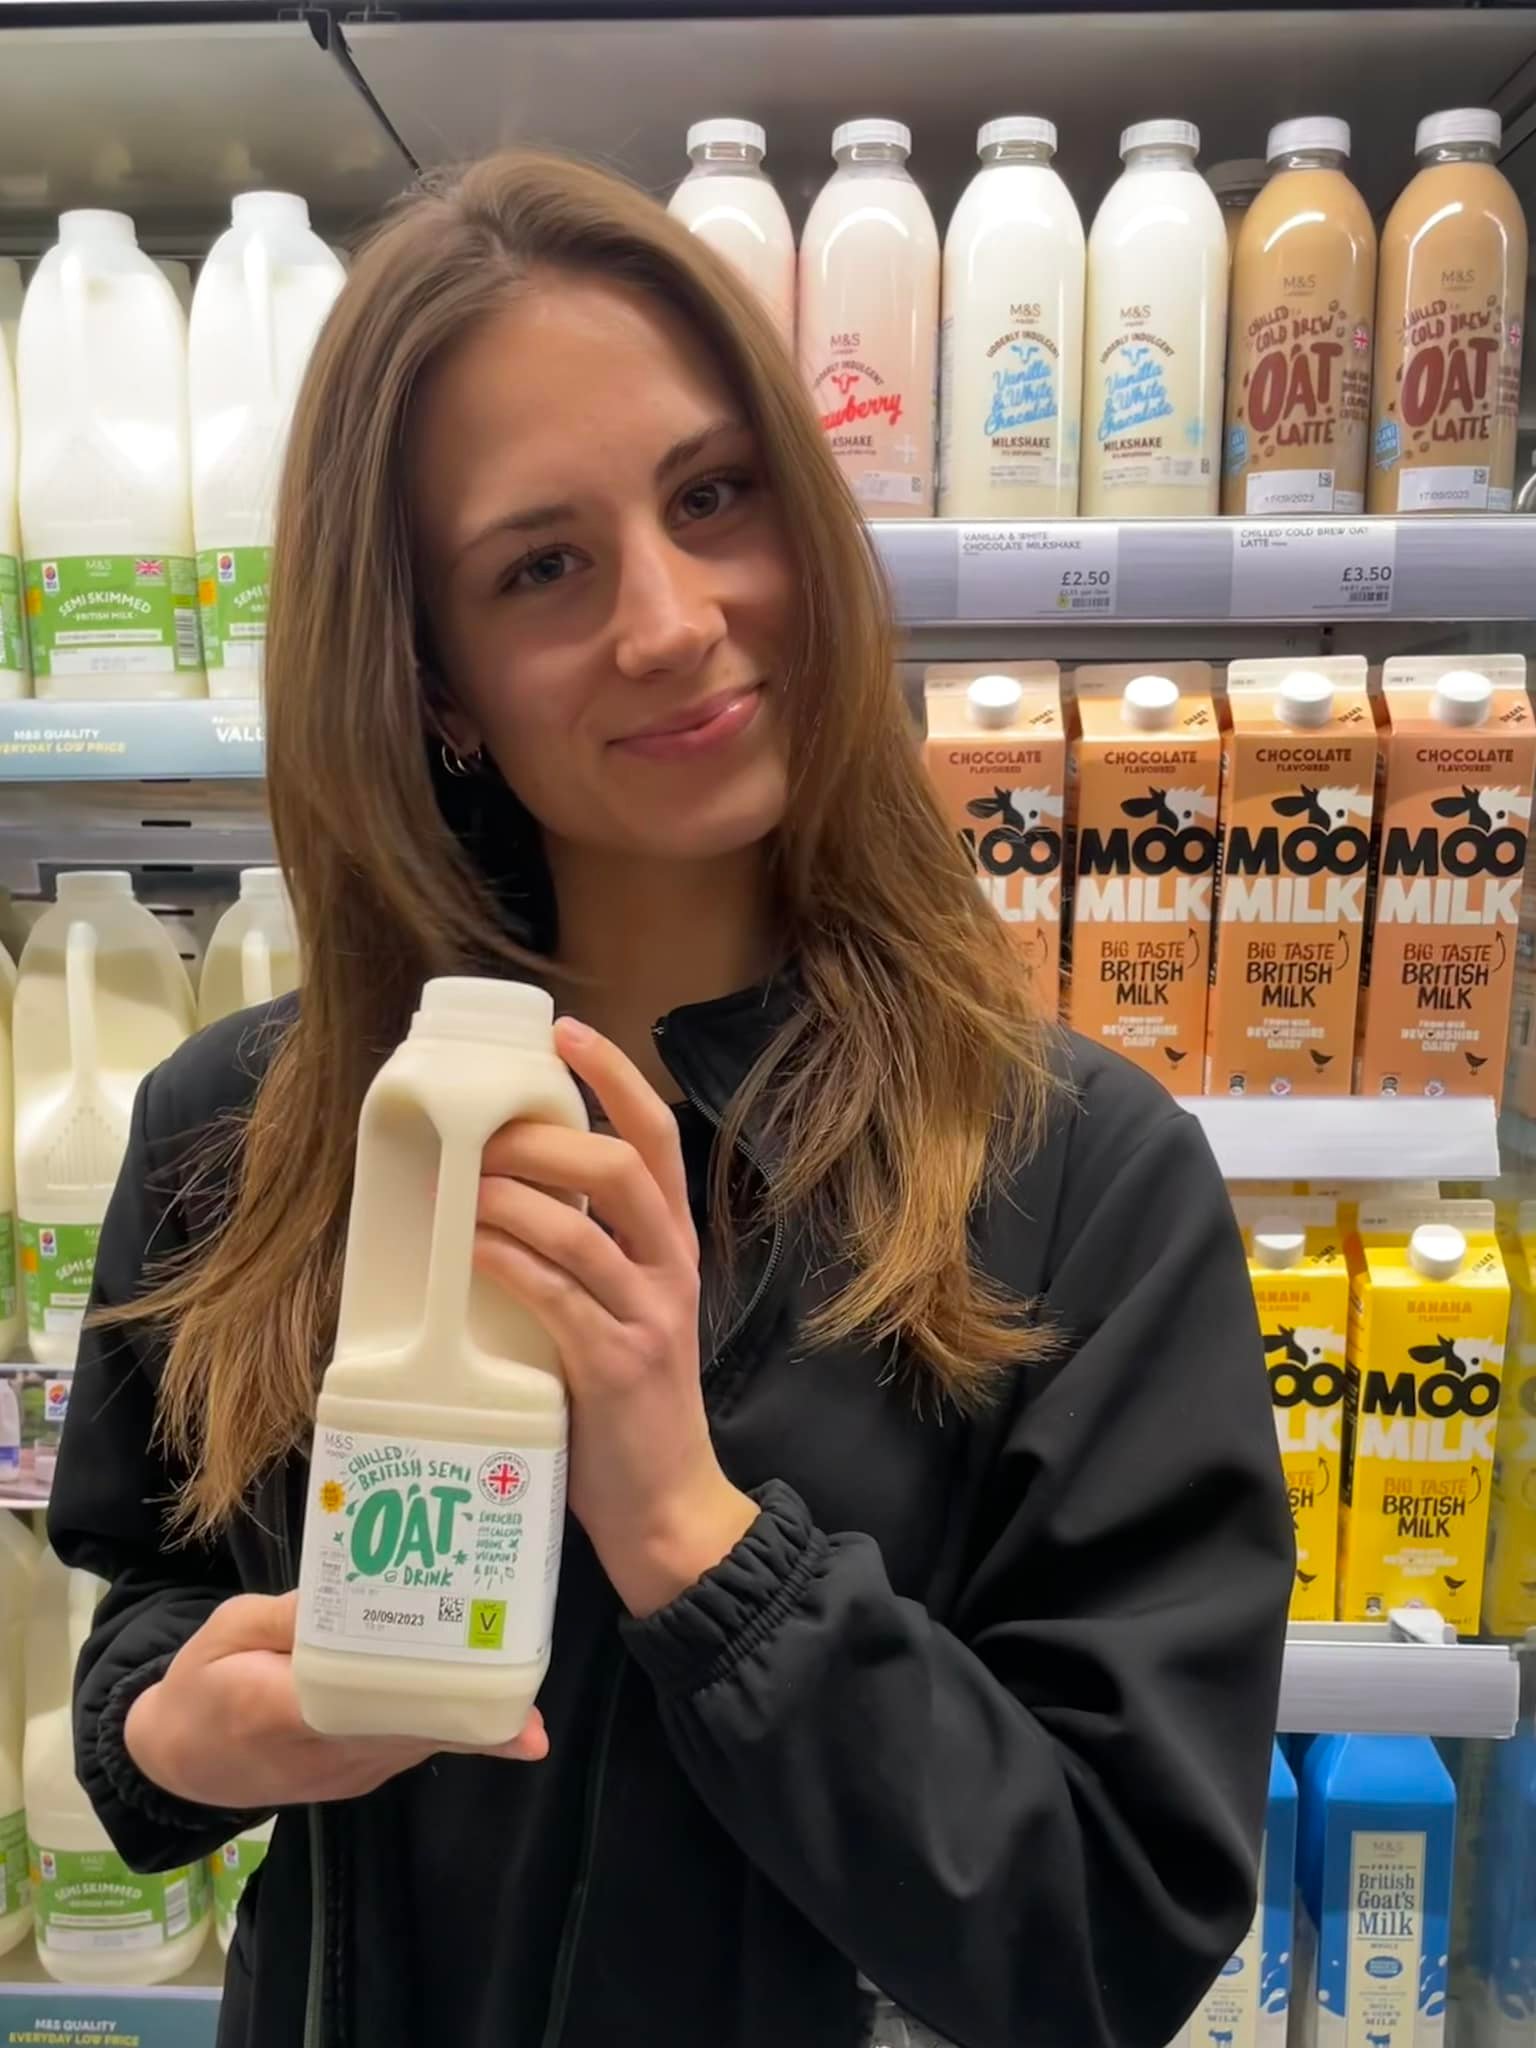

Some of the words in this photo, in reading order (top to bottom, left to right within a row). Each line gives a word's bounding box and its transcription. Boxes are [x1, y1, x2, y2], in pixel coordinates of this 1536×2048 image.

[1283, 275, 1315, 289] M&S
[1441, 270, 1475, 283] M&S
[1010, 304, 1041, 317] M&S
[1120, 306, 1151, 319] M&S
[1257, 327, 1287, 351] COLD
[1293, 315, 1334, 338] BREW
[1411, 320, 1444, 346] COLD
[1451, 311, 1490, 334] BREW
[1248, 342, 1343, 432] OAT
[1401, 337, 1499, 427] OAT
[1276, 418, 1336, 446] LATTE
[1432, 415, 1491, 443] LATTE
[992, 437, 1050, 449] MILKSHAKE
[1104, 437, 1162, 452] MILKSHAKE
[1286, 528, 1313, 537] COLD
[963, 542, 1022, 551] CHOCOLATE
[1240, 539, 1268, 548] LATTE
[1061, 570, 1111, 586] £2.50
[1342, 566, 1392, 583] £3.50
[59, 594, 86, 616] SEMI
[88, 591, 151, 614] SKIMMED
[234, 585, 263, 608] SEMI
[43, 728, 100, 741] QUALITY
[950, 751, 1042, 764] CHOCOLATE
[1104, 751, 1197, 764] CHOCOLATE
[1256, 749, 1352, 762] CHOCOLATE
[1416, 749, 1514, 763] CHOCOLATE
[1079, 827, 1216, 876] MOO
[1225, 826, 1369, 876] MOO
[1383, 827, 1527, 878] MOO
[1075, 877, 1213, 923] MILK
[1221, 877, 1366, 923] MILK
[1378, 877, 1522, 924] MILK
[1137, 942, 1185, 959] TASTE
[1284, 943, 1335, 960] TASTE
[1440, 944, 1493, 962] TASTE
[1101, 961, 1183, 982] BRITISH
[1246, 962, 1332, 985] BRITISH
[1402, 963, 1489, 985] BRITISH
[1257, 1292, 1312, 1304] ANANA
[1407, 1301, 1472, 1314] BANANA
[1267, 1363, 1346, 1408] OO
[1362, 1371, 1500, 1418] MOO
[1274, 1409, 1341, 1453] LK
[1357, 1417, 1496, 1461] MILK
[348, 1446, 402, 1474] CHILLED
[358, 1459, 422, 1491] BRITISH
[428, 1461, 470, 1482] SEMI
[1420, 1478, 1468, 1494] TASTE
[1382, 1495, 1465, 1516] BRITISH
[351, 1485, 472, 1576] OAT
[404, 1566, 453, 1587] DRINK
[362, 1609, 425, 1626] 20/09/2023
[480, 1612, 497, 1631] V
[1358, 1873, 1415, 1890] British
[83, 1883, 143, 1900] SKIMMED
[1357, 1890, 1415, 1910] Goat's
[1357, 1911, 1414, 1936] Milk
[35, 2019, 61, 2031] M&S
[63, 2019, 116, 2032] QUALITY
[9, 2032, 72, 2046] EVERYDAY
[75, 2033, 101, 2046] LOW
[104, 2034, 139, 2048] PRICE
